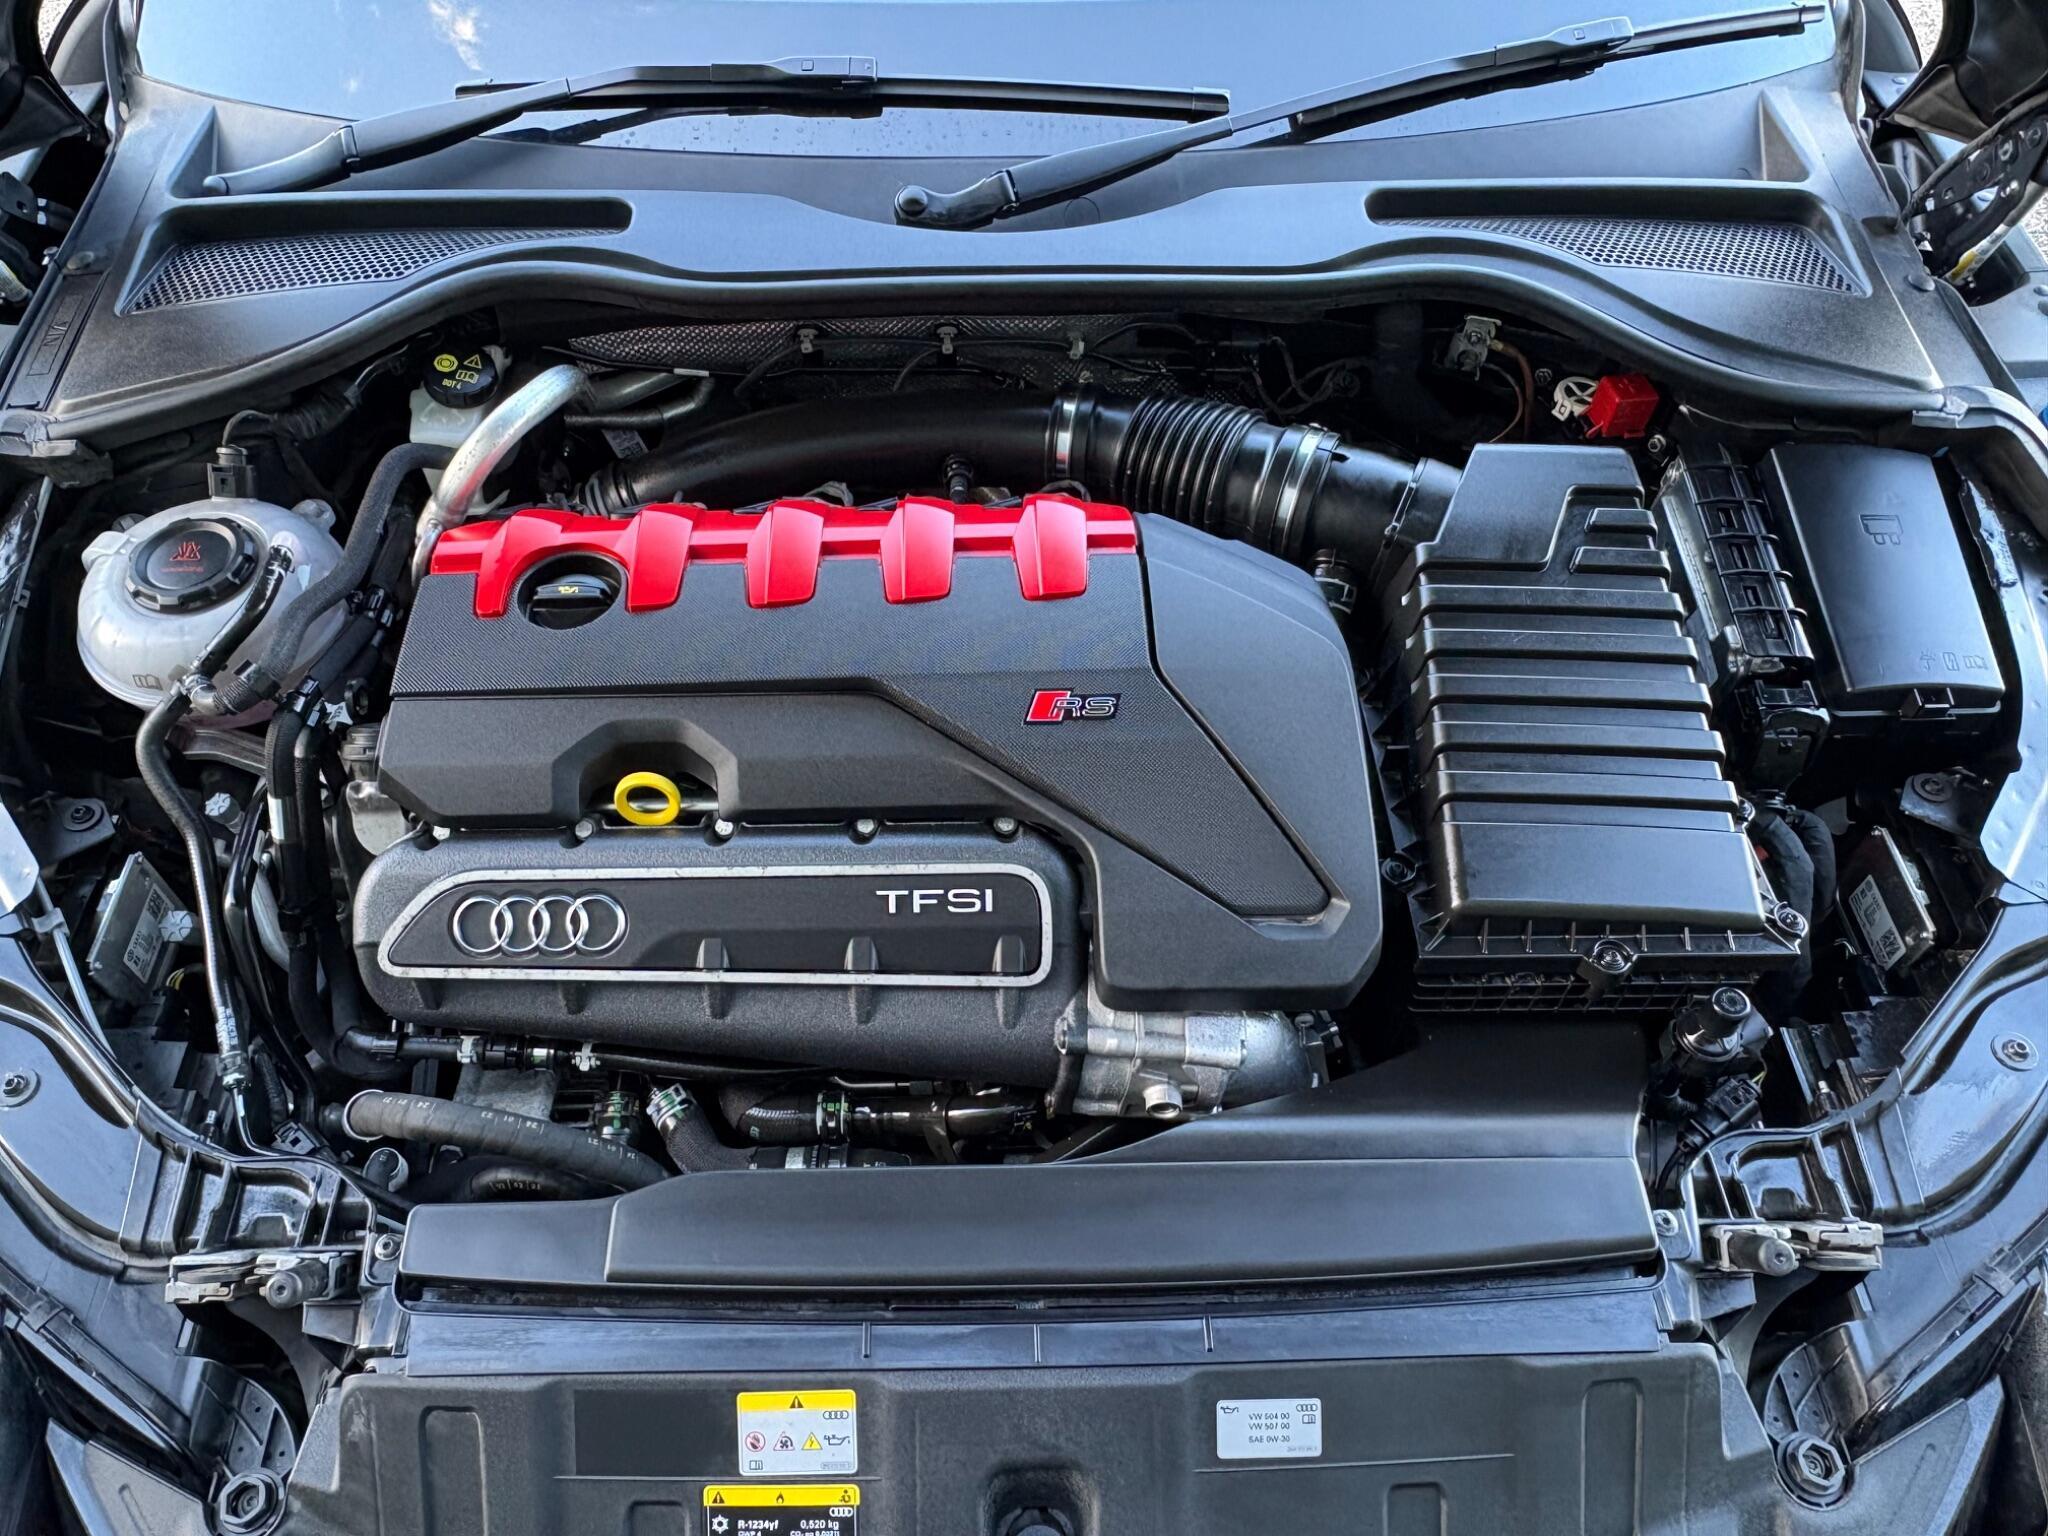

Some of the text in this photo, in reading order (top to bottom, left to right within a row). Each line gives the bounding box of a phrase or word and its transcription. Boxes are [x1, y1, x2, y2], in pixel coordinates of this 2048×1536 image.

[1038, 691, 1117, 720] RS
[875, 888, 993, 914] TFSI
[1248, 1412, 1263, 1420] VW
[1281, 1412, 1290, 1420] 00
[1248, 1422, 1263, 1430] VW
[1281, 1422, 1290, 1430] 00
[737, 1519, 779, 1531] R-1234yf
[828, 1519, 840, 1531] kg
